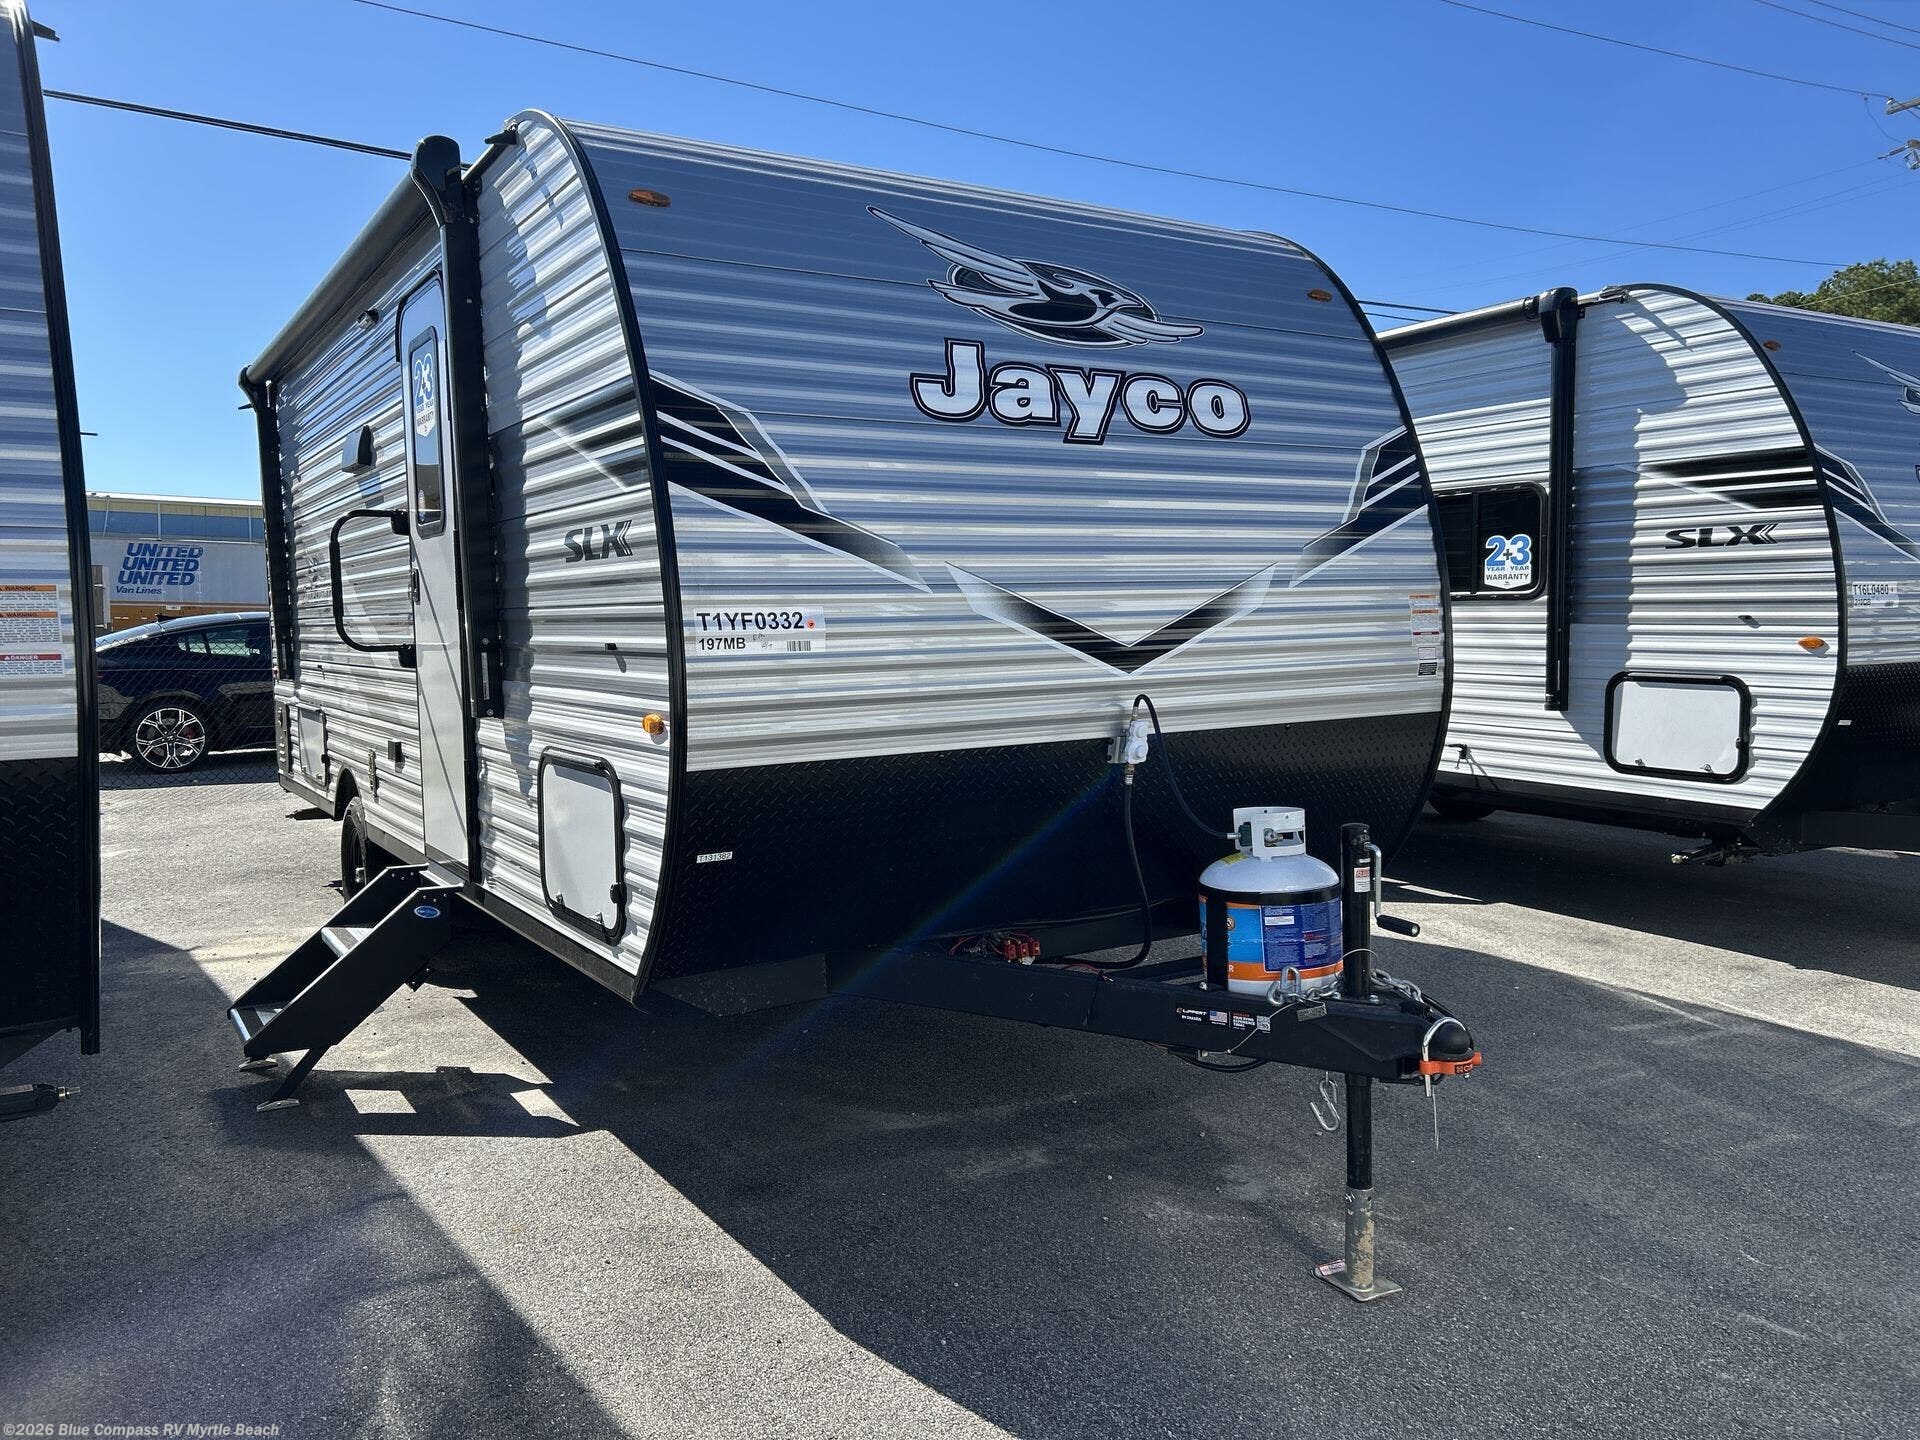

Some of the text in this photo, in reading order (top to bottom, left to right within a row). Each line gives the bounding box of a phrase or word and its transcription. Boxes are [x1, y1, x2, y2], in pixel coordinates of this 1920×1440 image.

[910, 338, 1251, 445] Jayco
[1664, 523, 1779, 549] SLX
[127, 543, 204, 559] UNITED
[122, 556, 200, 572] UNITED
[117, 571, 196, 586] UNITED
[116, 585, 162, 595] Van Lines
[696, 612, 804, 631] T1YF0332
[698, 637, 746, 650] 197MB
